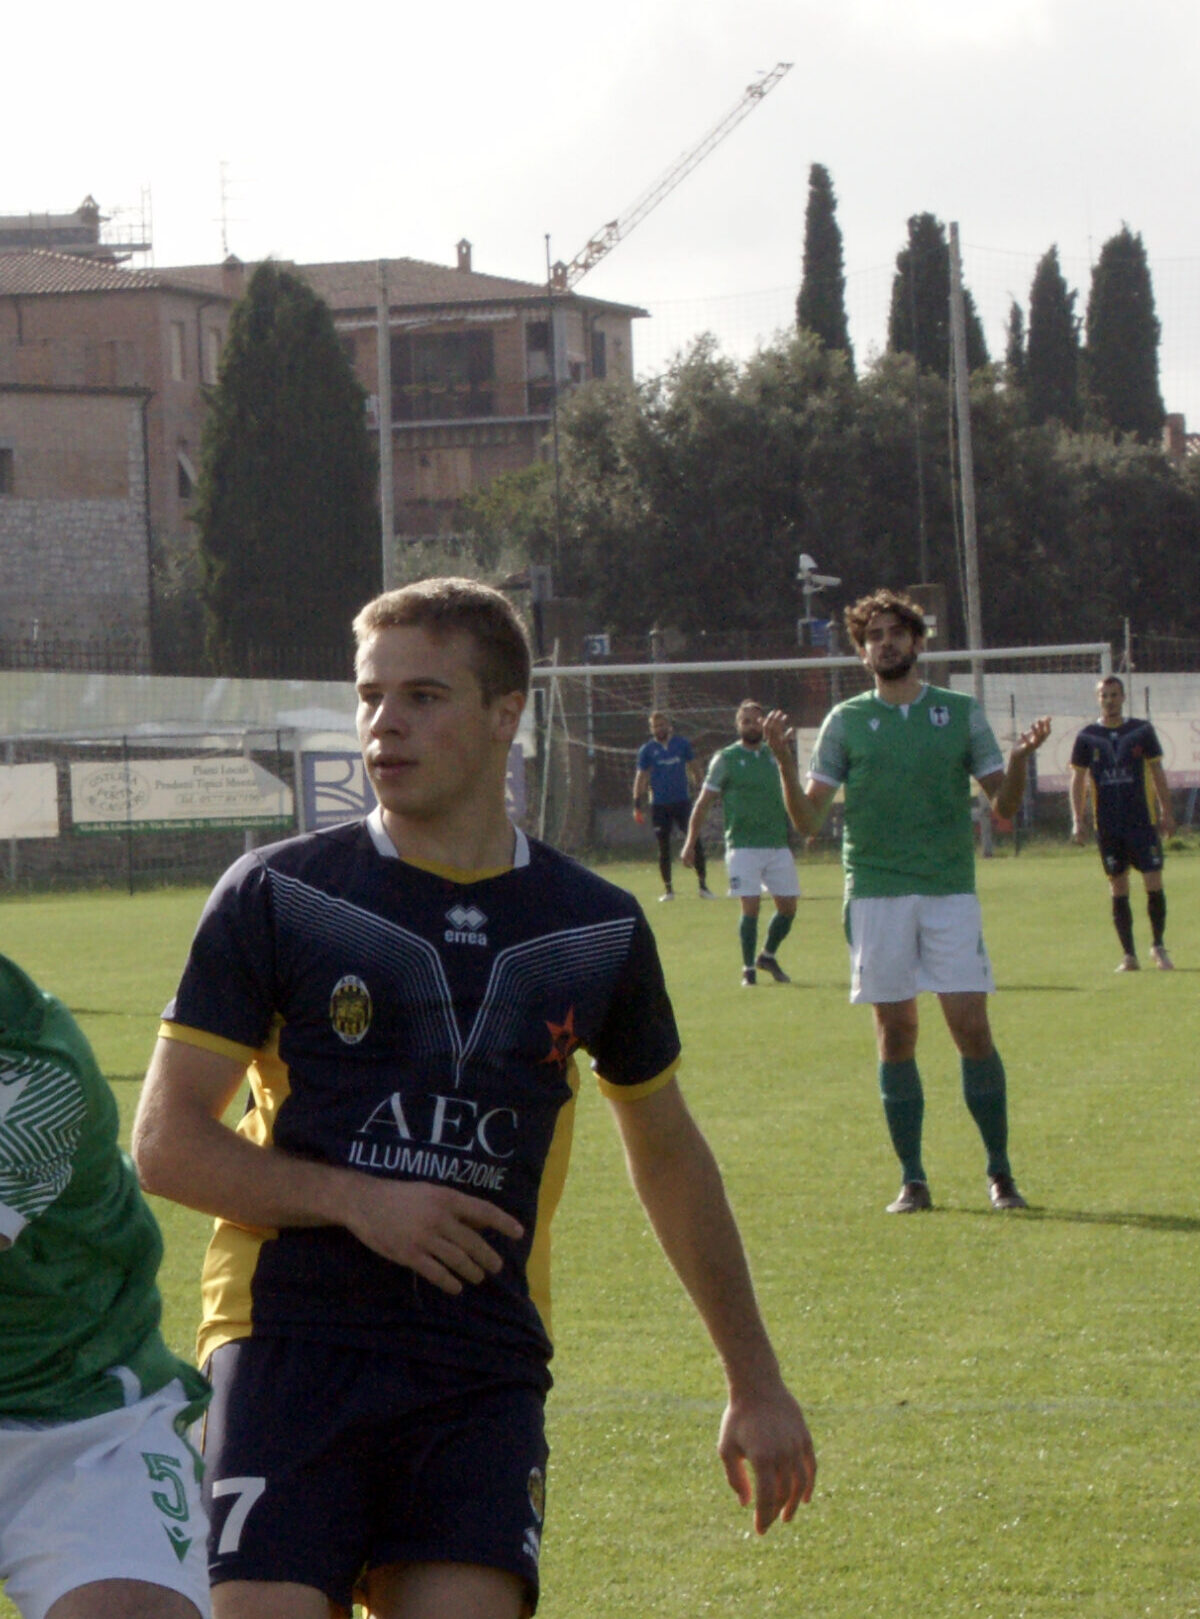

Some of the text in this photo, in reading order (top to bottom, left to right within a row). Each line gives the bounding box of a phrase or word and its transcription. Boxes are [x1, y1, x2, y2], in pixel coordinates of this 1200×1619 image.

[356, 1092, 518, 1158] AEC
[349, 1141, 508, 1191] ILLUMINAZIONE
[142, 1453, 189, 1522] 5
[212, 1477, 266, 1555] 7
